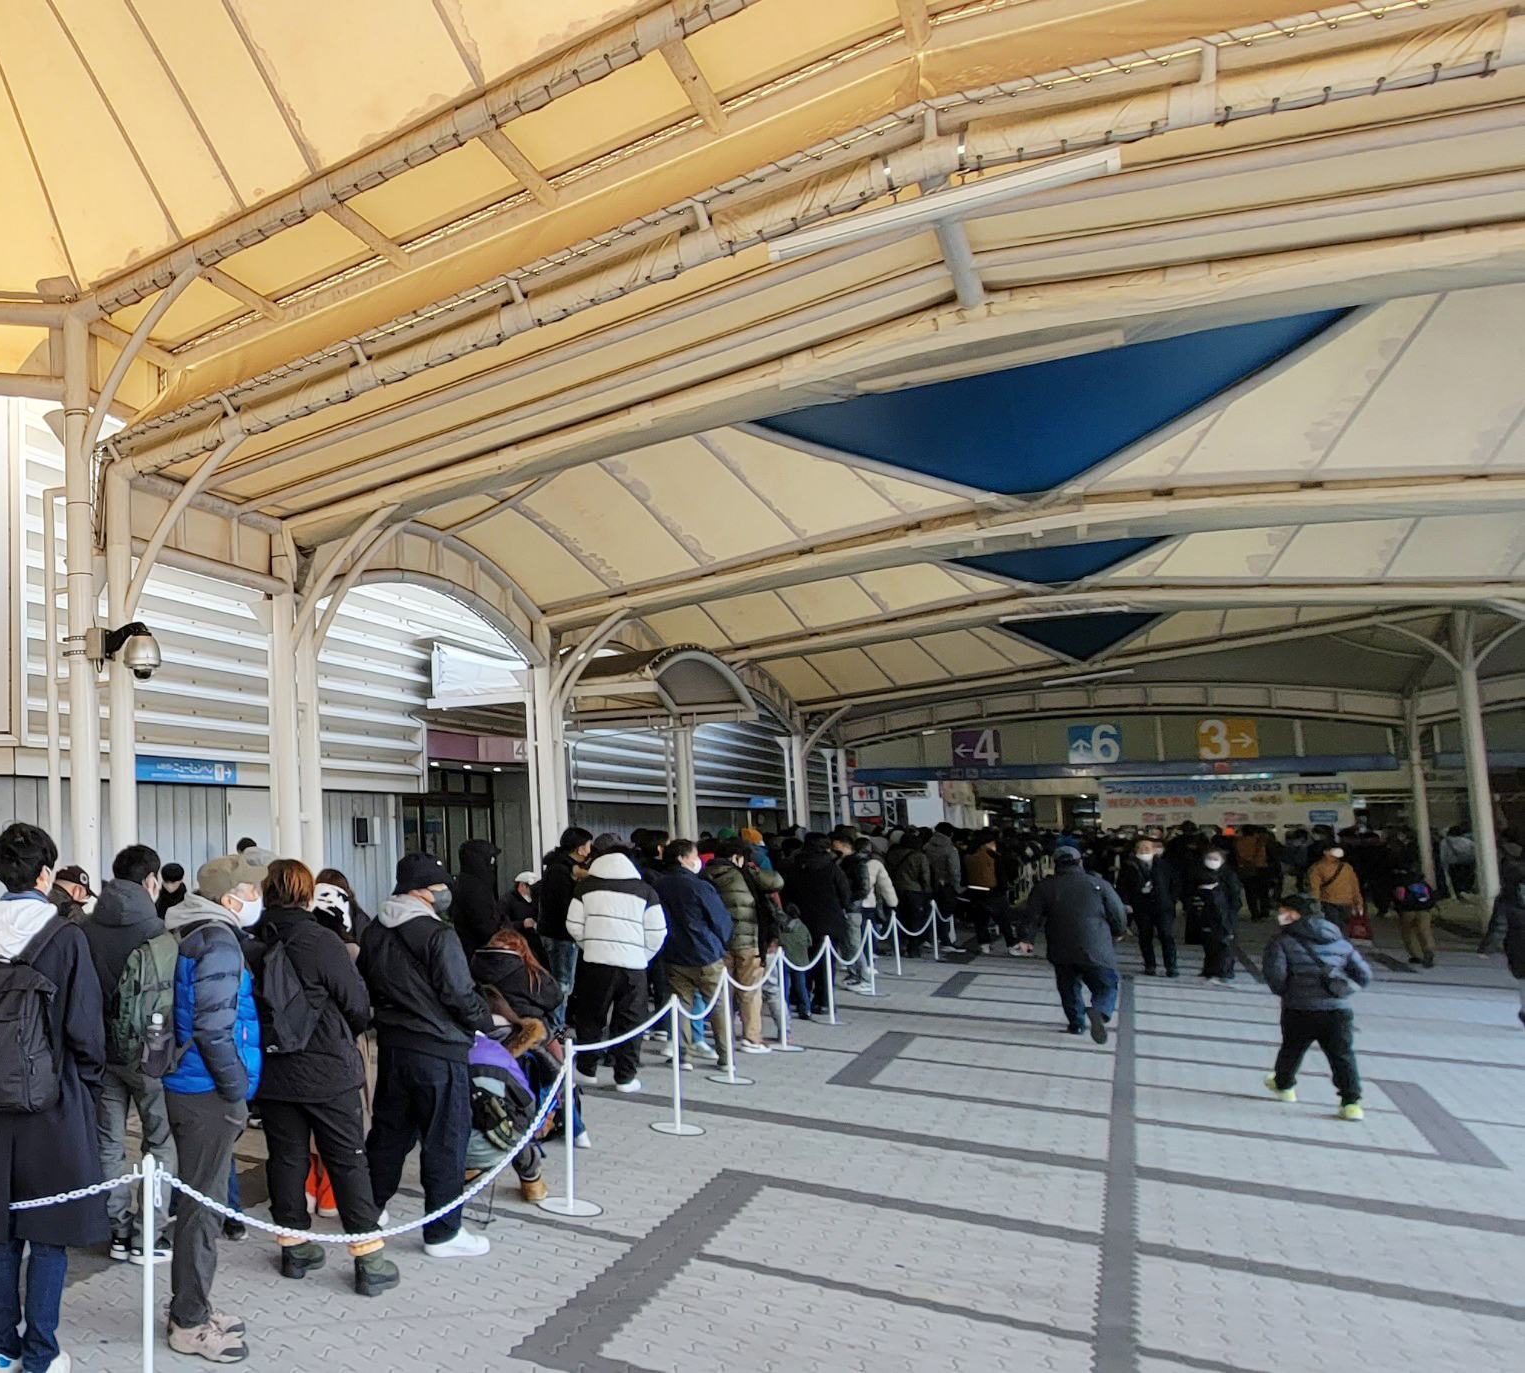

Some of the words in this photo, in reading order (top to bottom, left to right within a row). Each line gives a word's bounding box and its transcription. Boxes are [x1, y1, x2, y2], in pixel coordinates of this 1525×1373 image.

[516, 740, 527, 760] 4
[973, 728, 999, 766] 4
[1092, 724, 1120, 762] 6
[1199, 720, 1230, 759] 3
